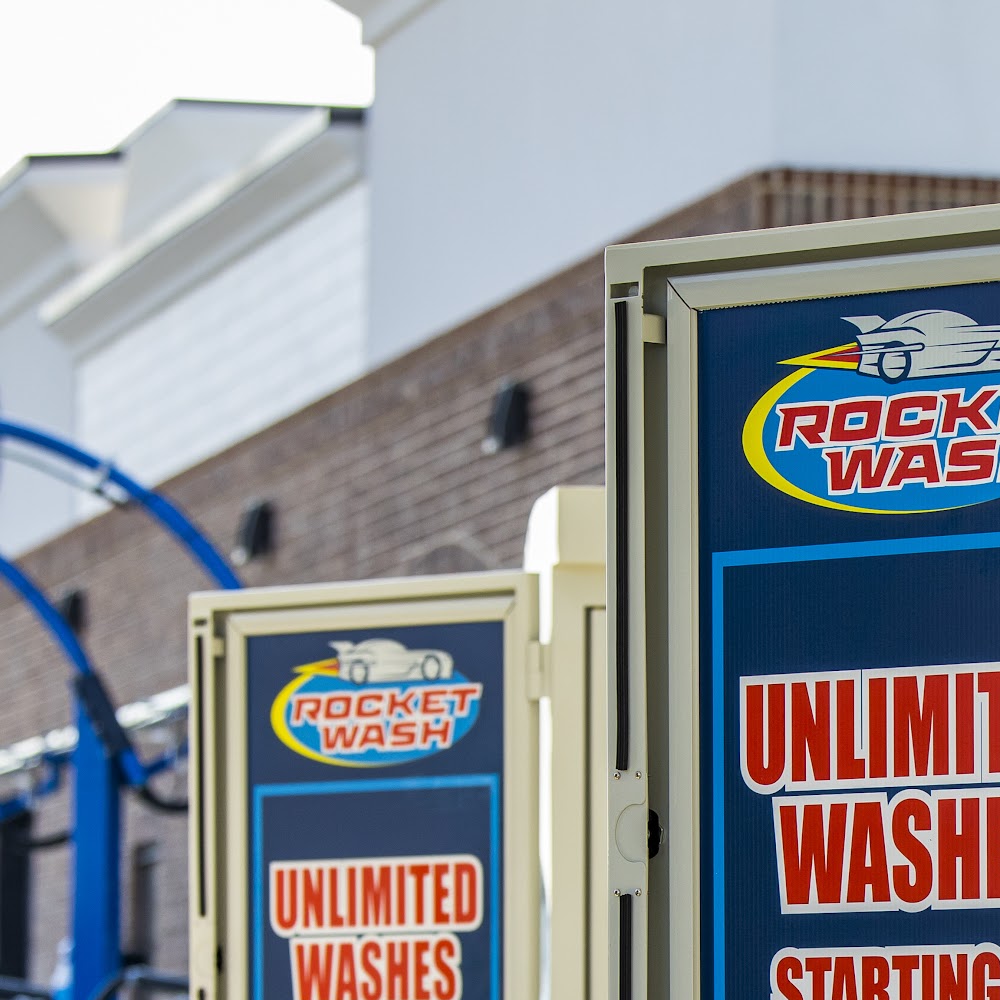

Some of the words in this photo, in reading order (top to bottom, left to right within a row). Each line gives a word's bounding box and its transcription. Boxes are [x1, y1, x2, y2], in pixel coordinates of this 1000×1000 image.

[291, 685, 481, 724] ROCKET
[322, 720, 451, 751] WASH
[272, 859, 479, 934] UNLIMITED
